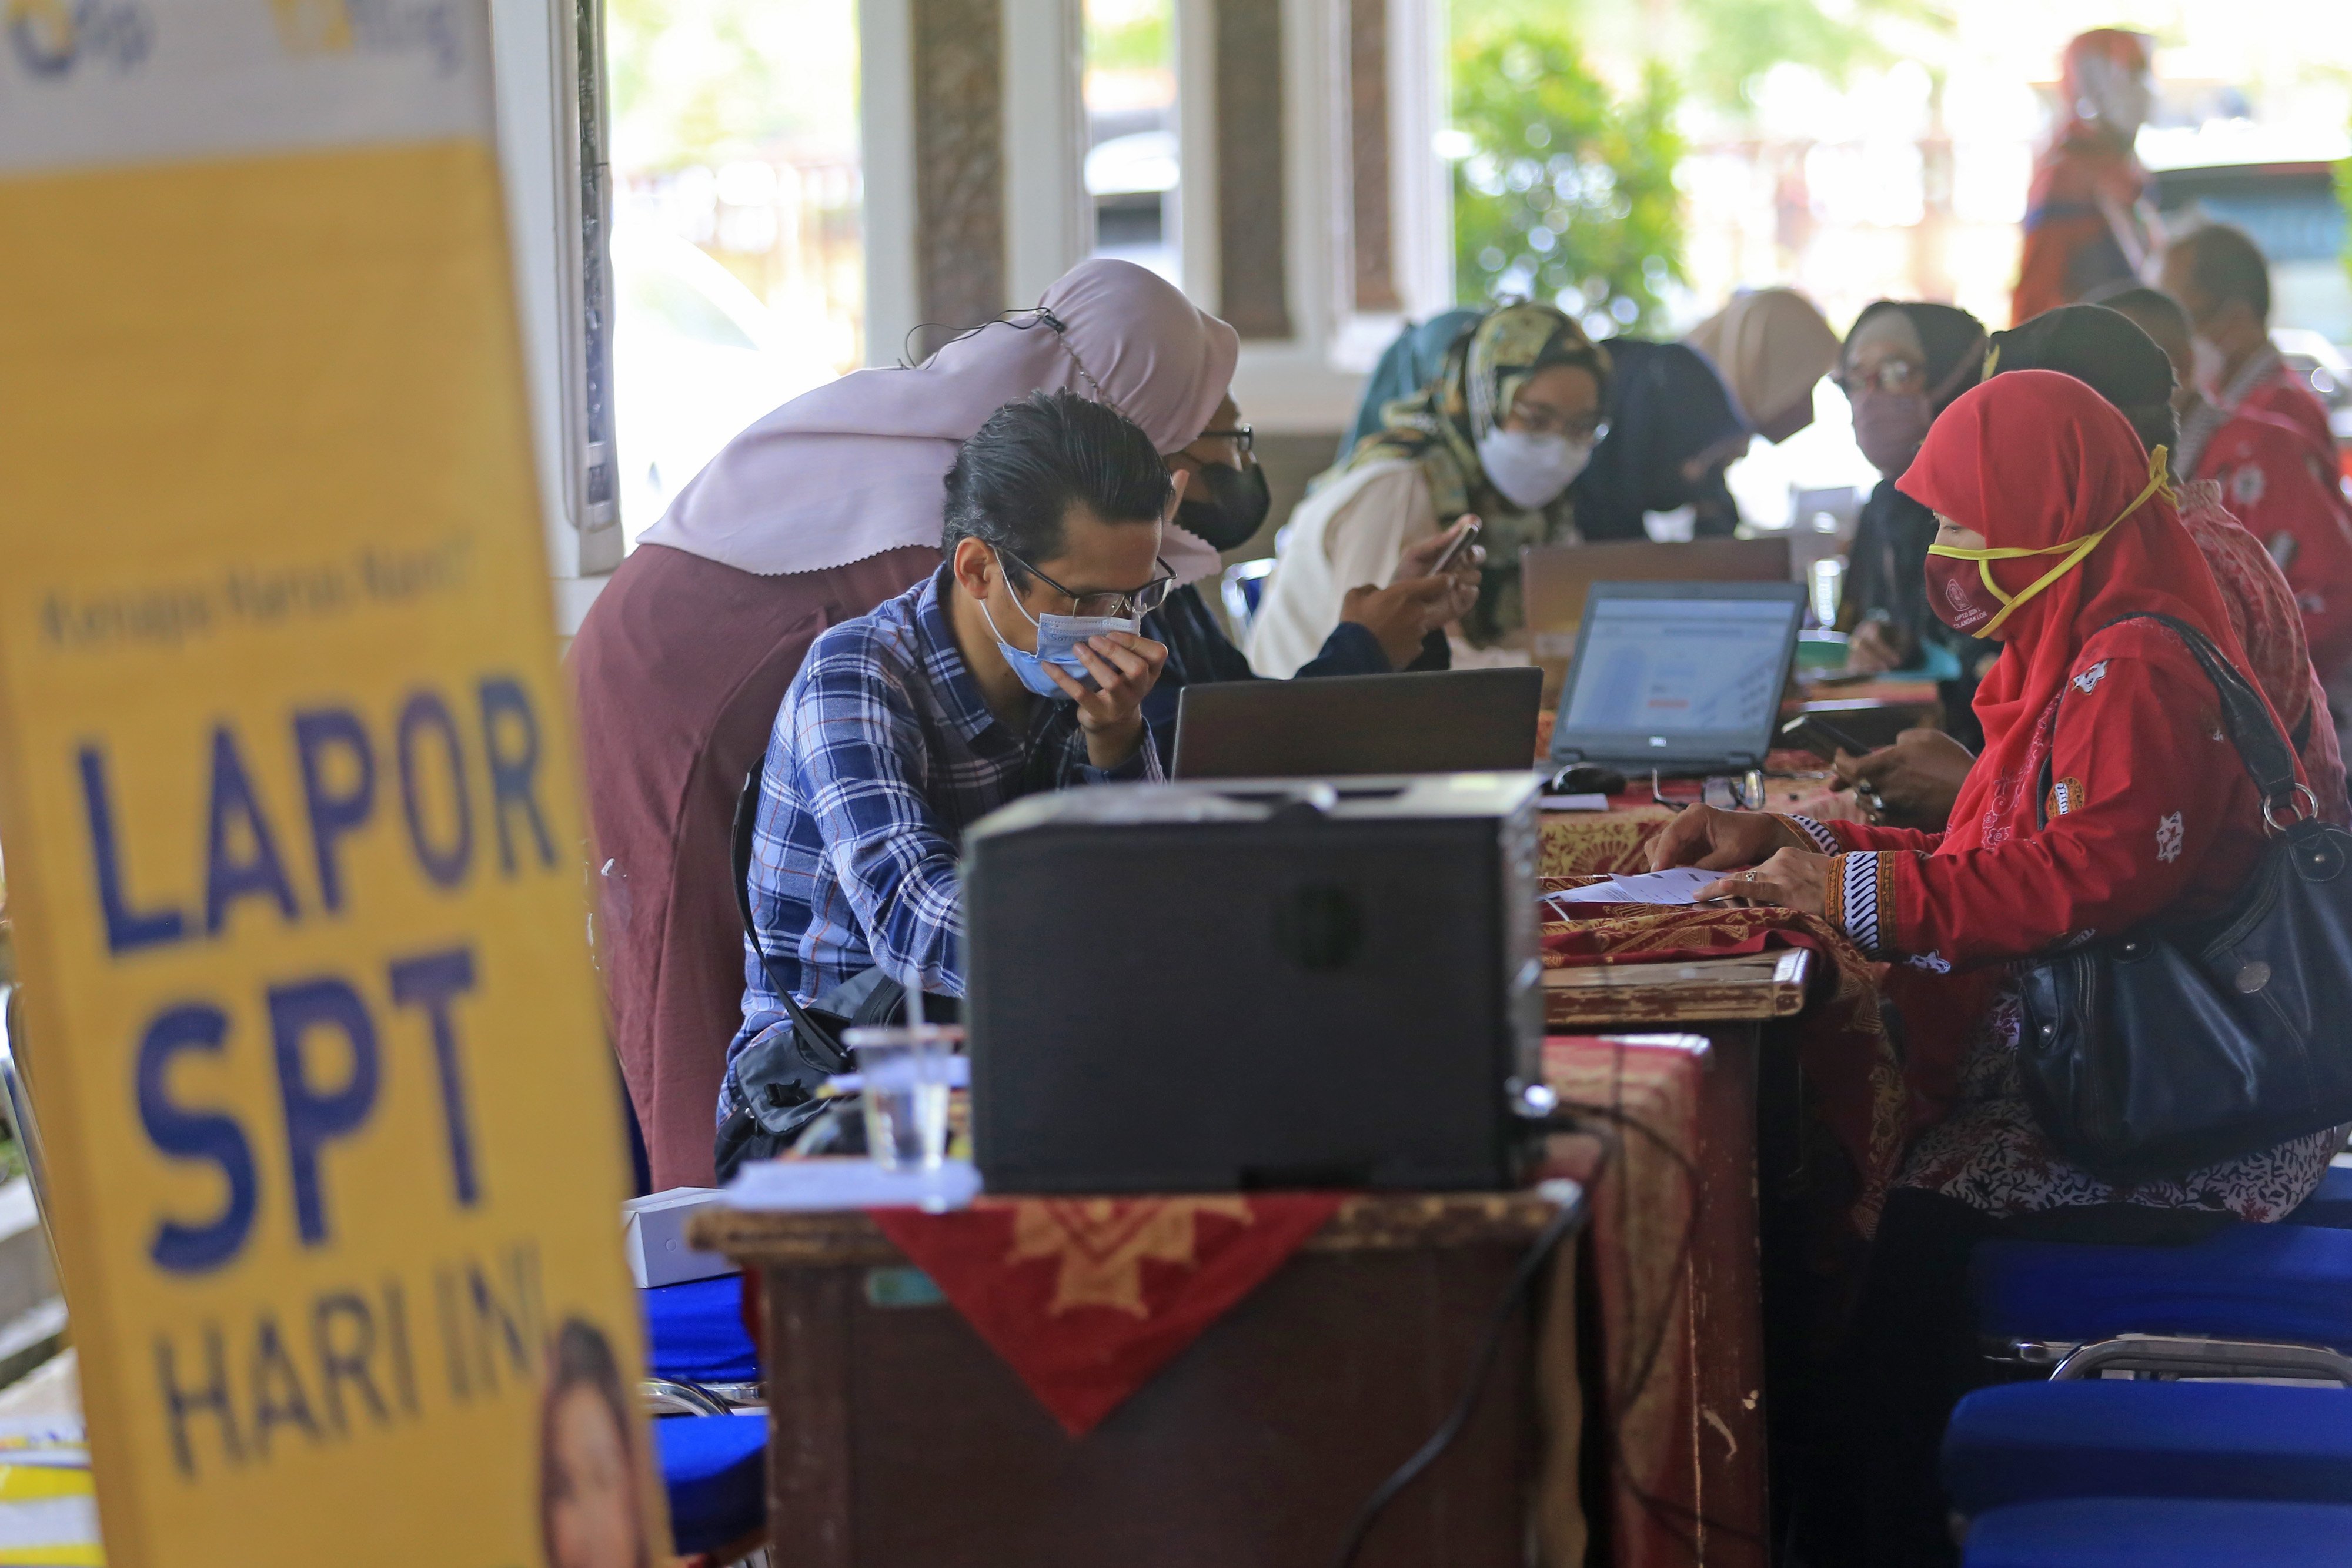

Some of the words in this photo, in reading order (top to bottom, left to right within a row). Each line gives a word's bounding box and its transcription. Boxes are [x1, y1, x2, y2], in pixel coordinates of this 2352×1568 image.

[1955, 612, 1969, 621] UPTD
[78, 674, 559, 956] LAPOR
[135, 944, 481, 1277] SPT
[155, 1275, 421, 1479] HARI
